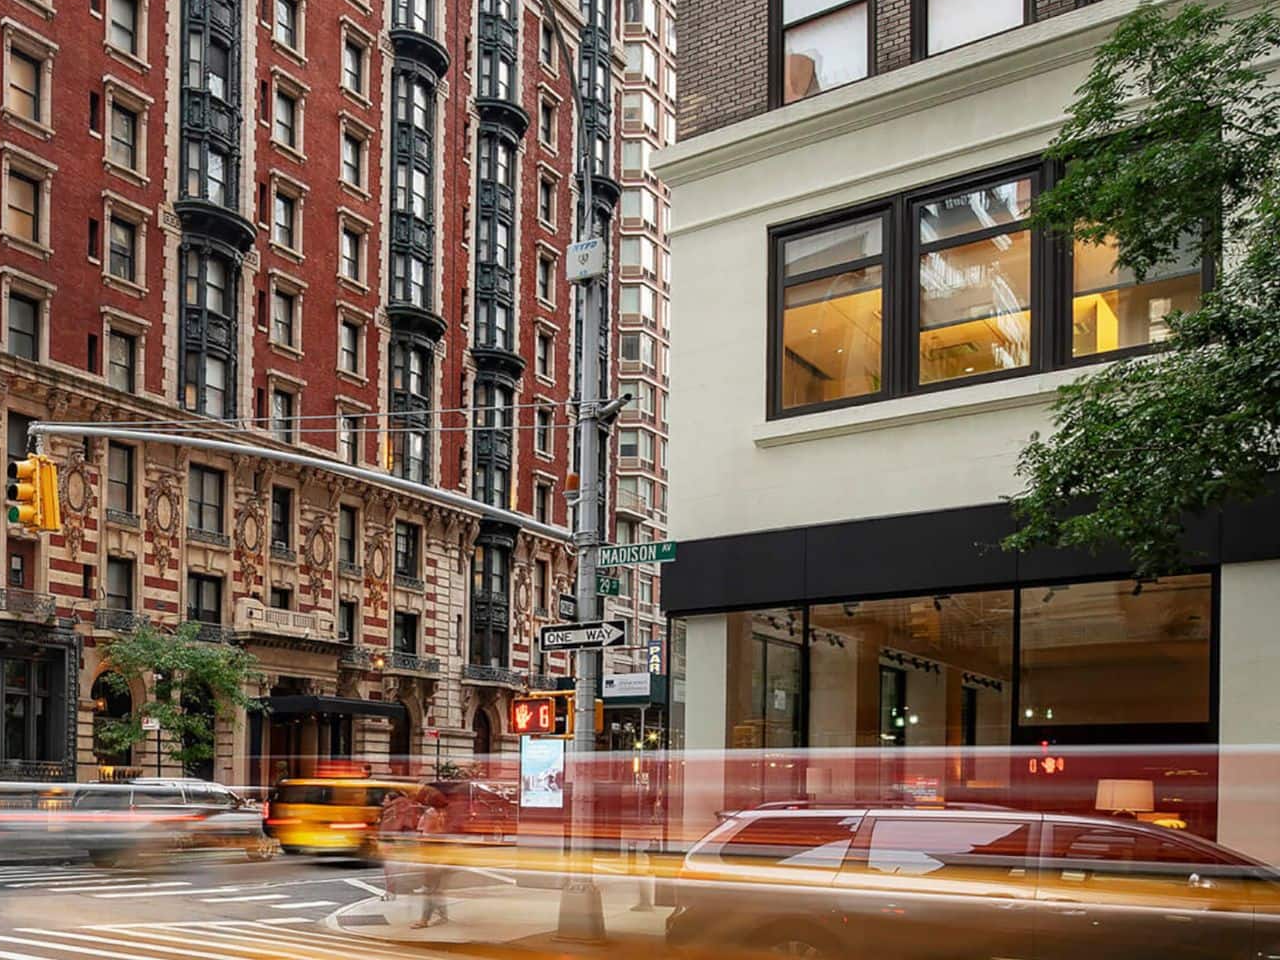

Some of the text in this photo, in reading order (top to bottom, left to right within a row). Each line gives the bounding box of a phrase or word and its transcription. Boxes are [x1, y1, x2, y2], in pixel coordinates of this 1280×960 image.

[602, 543, 672, 564] MADISON AV
[600, 578, 611, 593] 29
[547, 628, 613, 644] ONE WAY
[539, 705, 549, 728] 6
